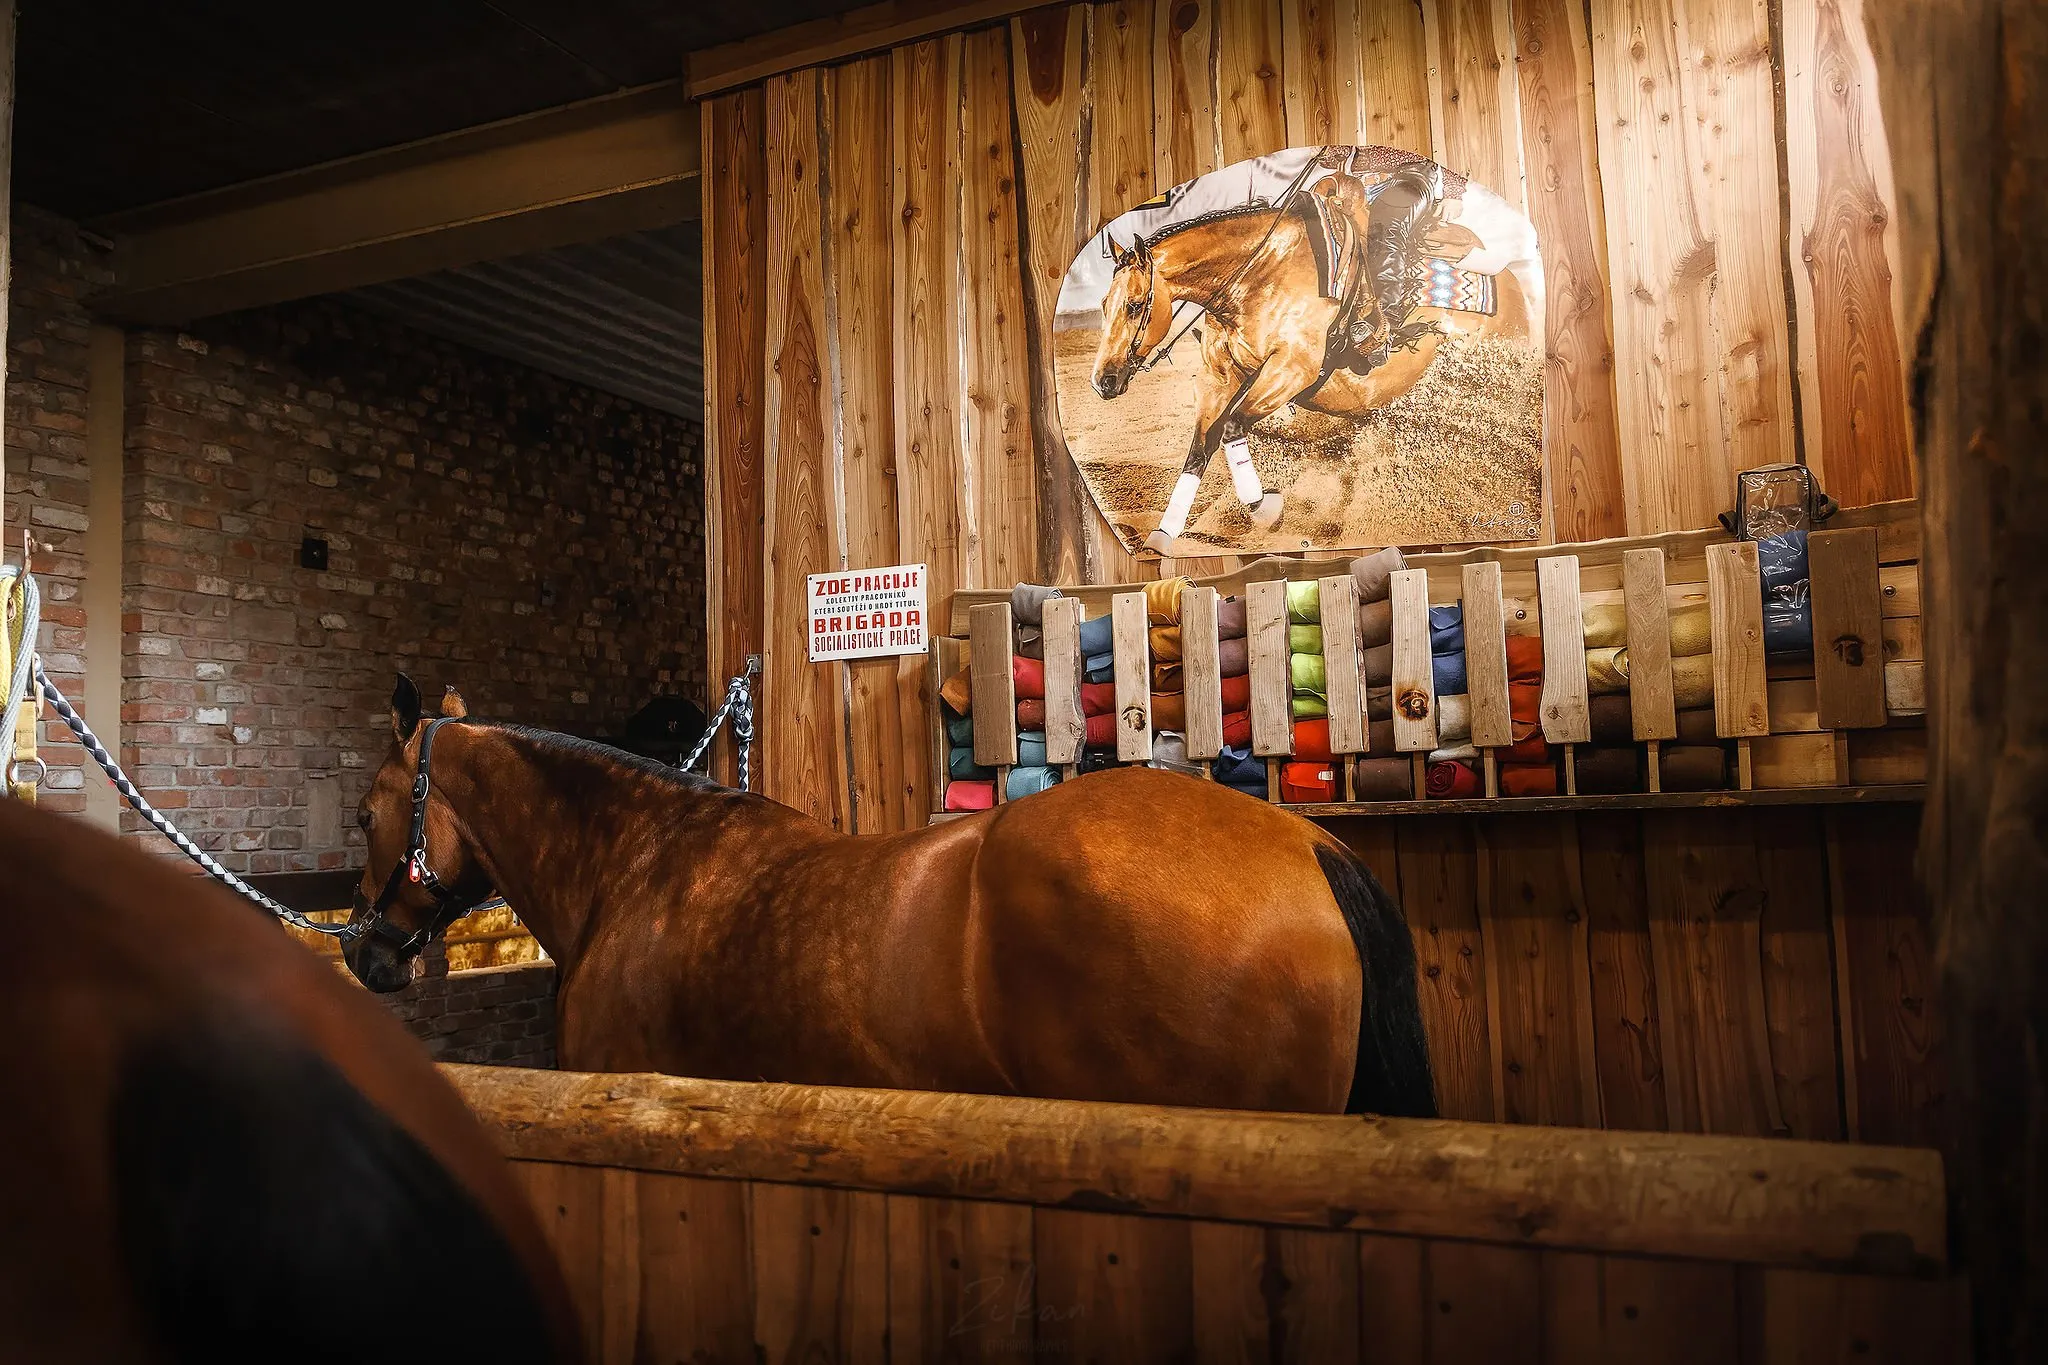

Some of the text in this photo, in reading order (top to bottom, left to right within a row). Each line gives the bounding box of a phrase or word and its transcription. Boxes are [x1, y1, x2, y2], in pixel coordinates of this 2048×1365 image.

[815, 572, 918, 596] ZDE PRACUJE
[826, 595, 859, 605] KOLEKTIV
[814, 610, 921, 634] BRIGÁDA
[815, 627, 921, 652] SOCIALISTICKÉ PRÁCE
